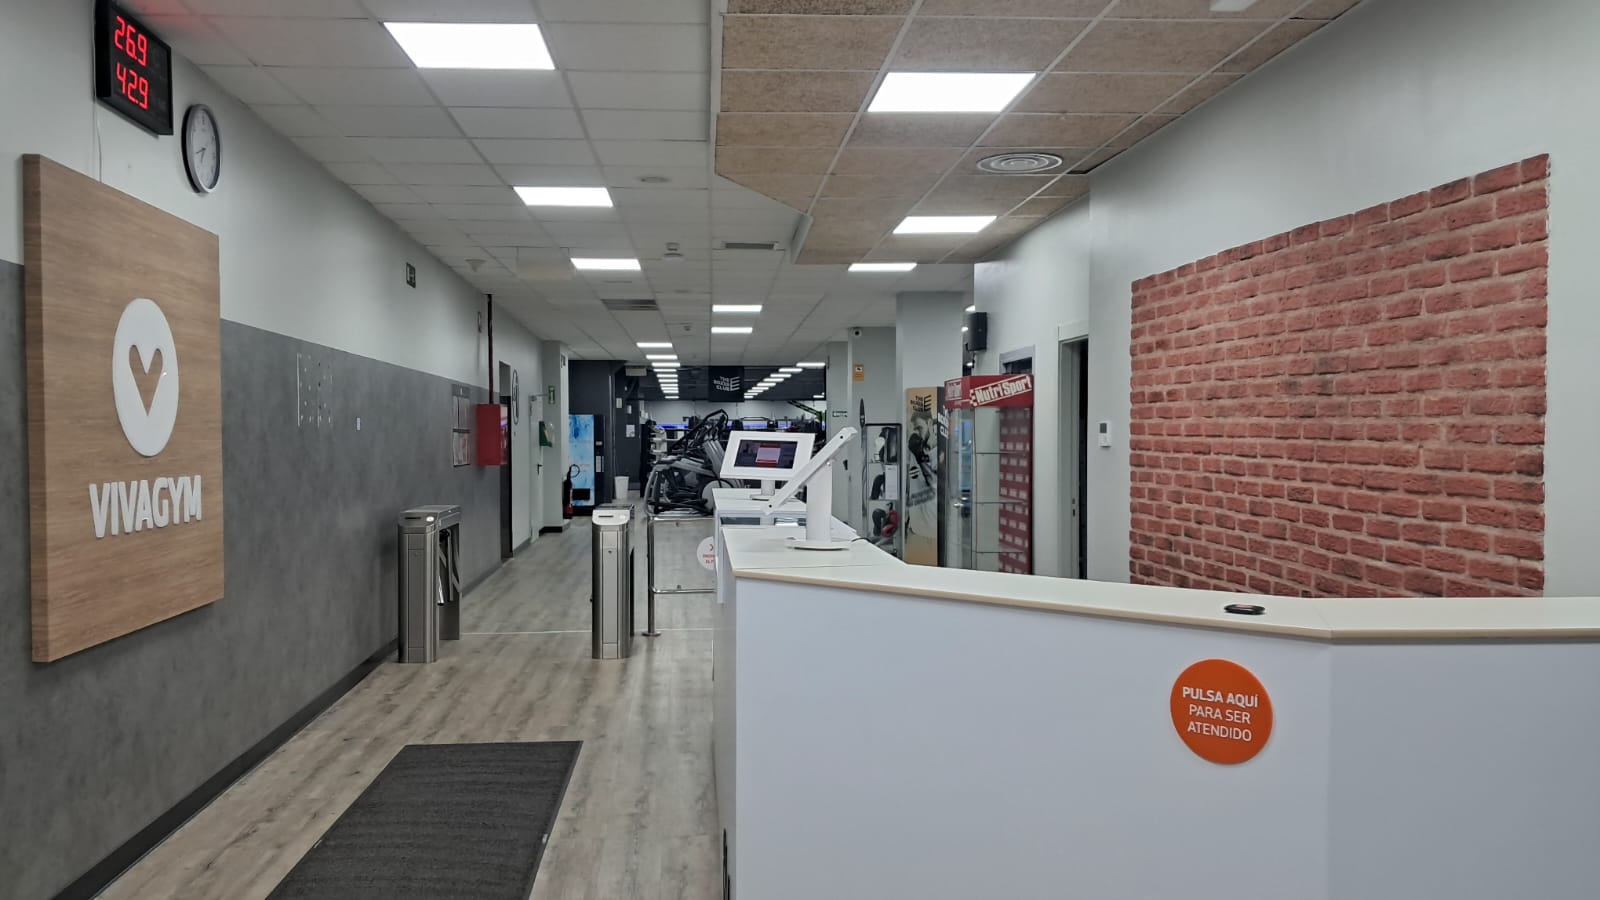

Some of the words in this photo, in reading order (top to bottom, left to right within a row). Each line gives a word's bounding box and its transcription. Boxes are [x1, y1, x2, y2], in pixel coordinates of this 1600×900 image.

[89, 475, 202, 538] VIVAGYM
[1182, 686, 1224, 703] PULSA
[1226, 692, 1259, 709] AQUÍ
[1189, 704, 1223, 721] PARA
[1225, 709, 1251, 724] SER
[1187, 721, 1252, 742] ATENDIDO
